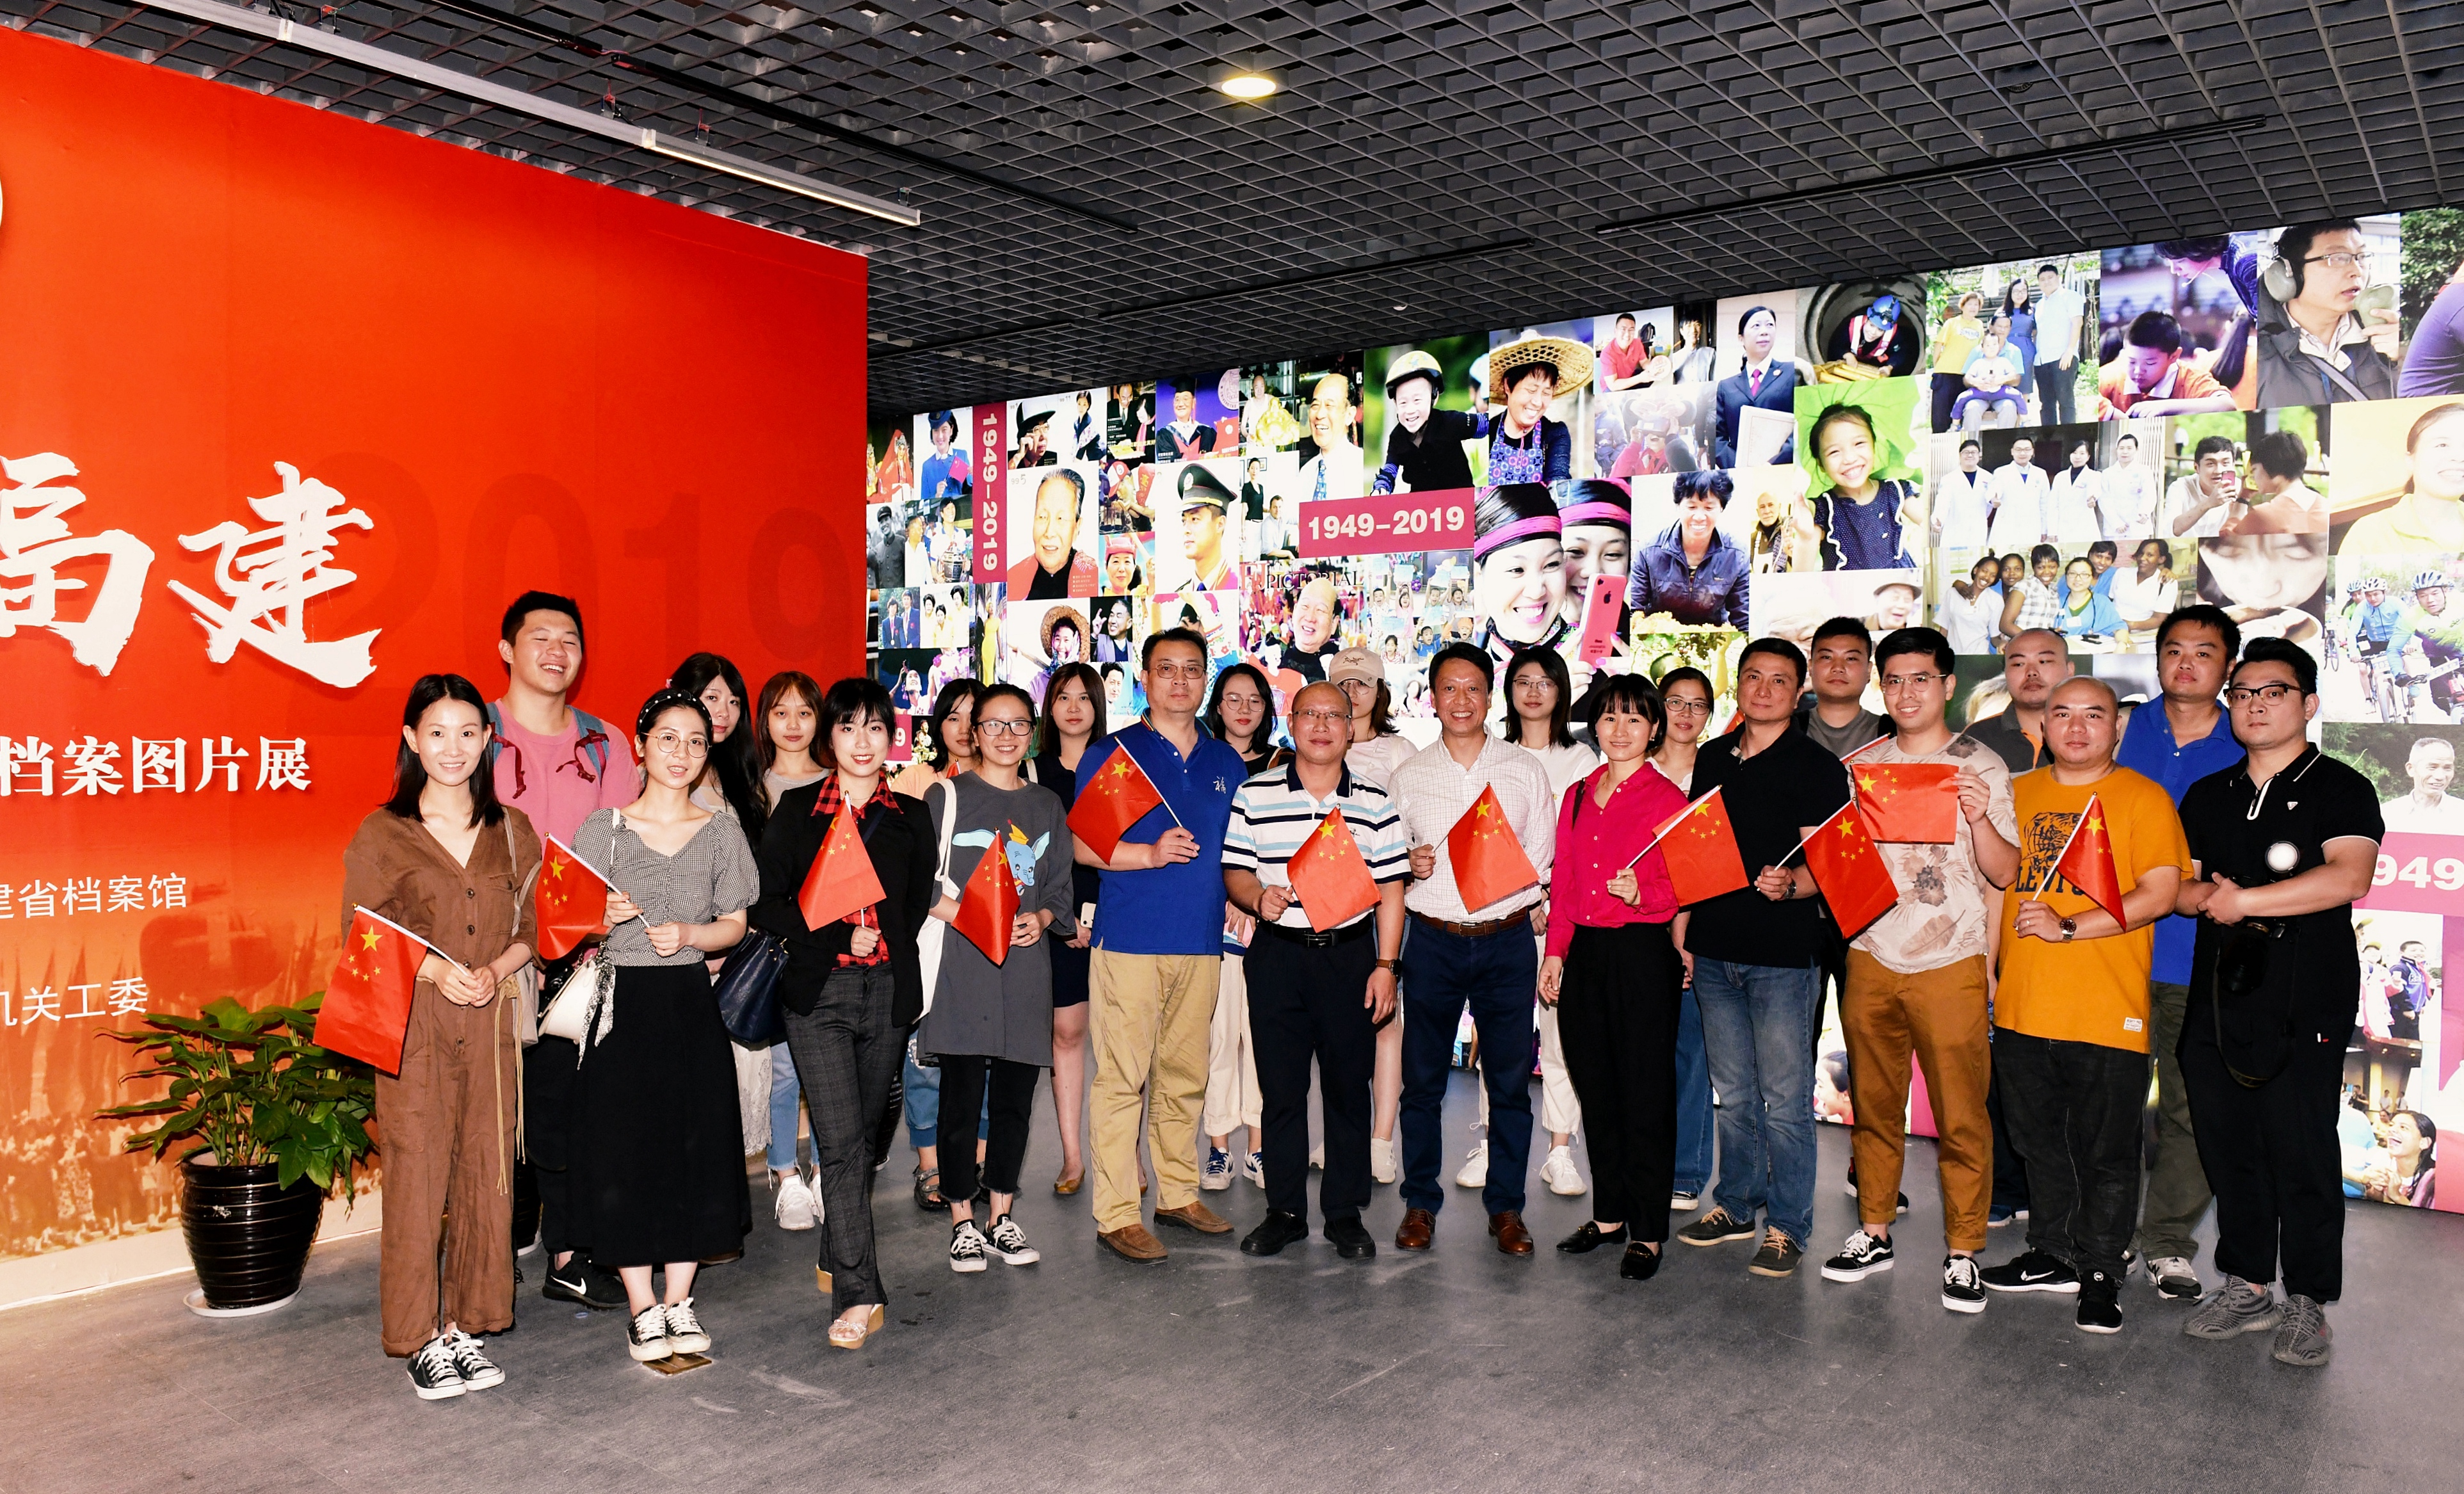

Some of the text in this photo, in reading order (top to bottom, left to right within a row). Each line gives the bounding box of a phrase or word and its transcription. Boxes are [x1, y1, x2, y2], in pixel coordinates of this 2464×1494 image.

[983, 413, 998, 571] 1949-2019
[1308, 506, 1465, 540] 1949-2019
[0, 735, 312, 797] 档案图片展
